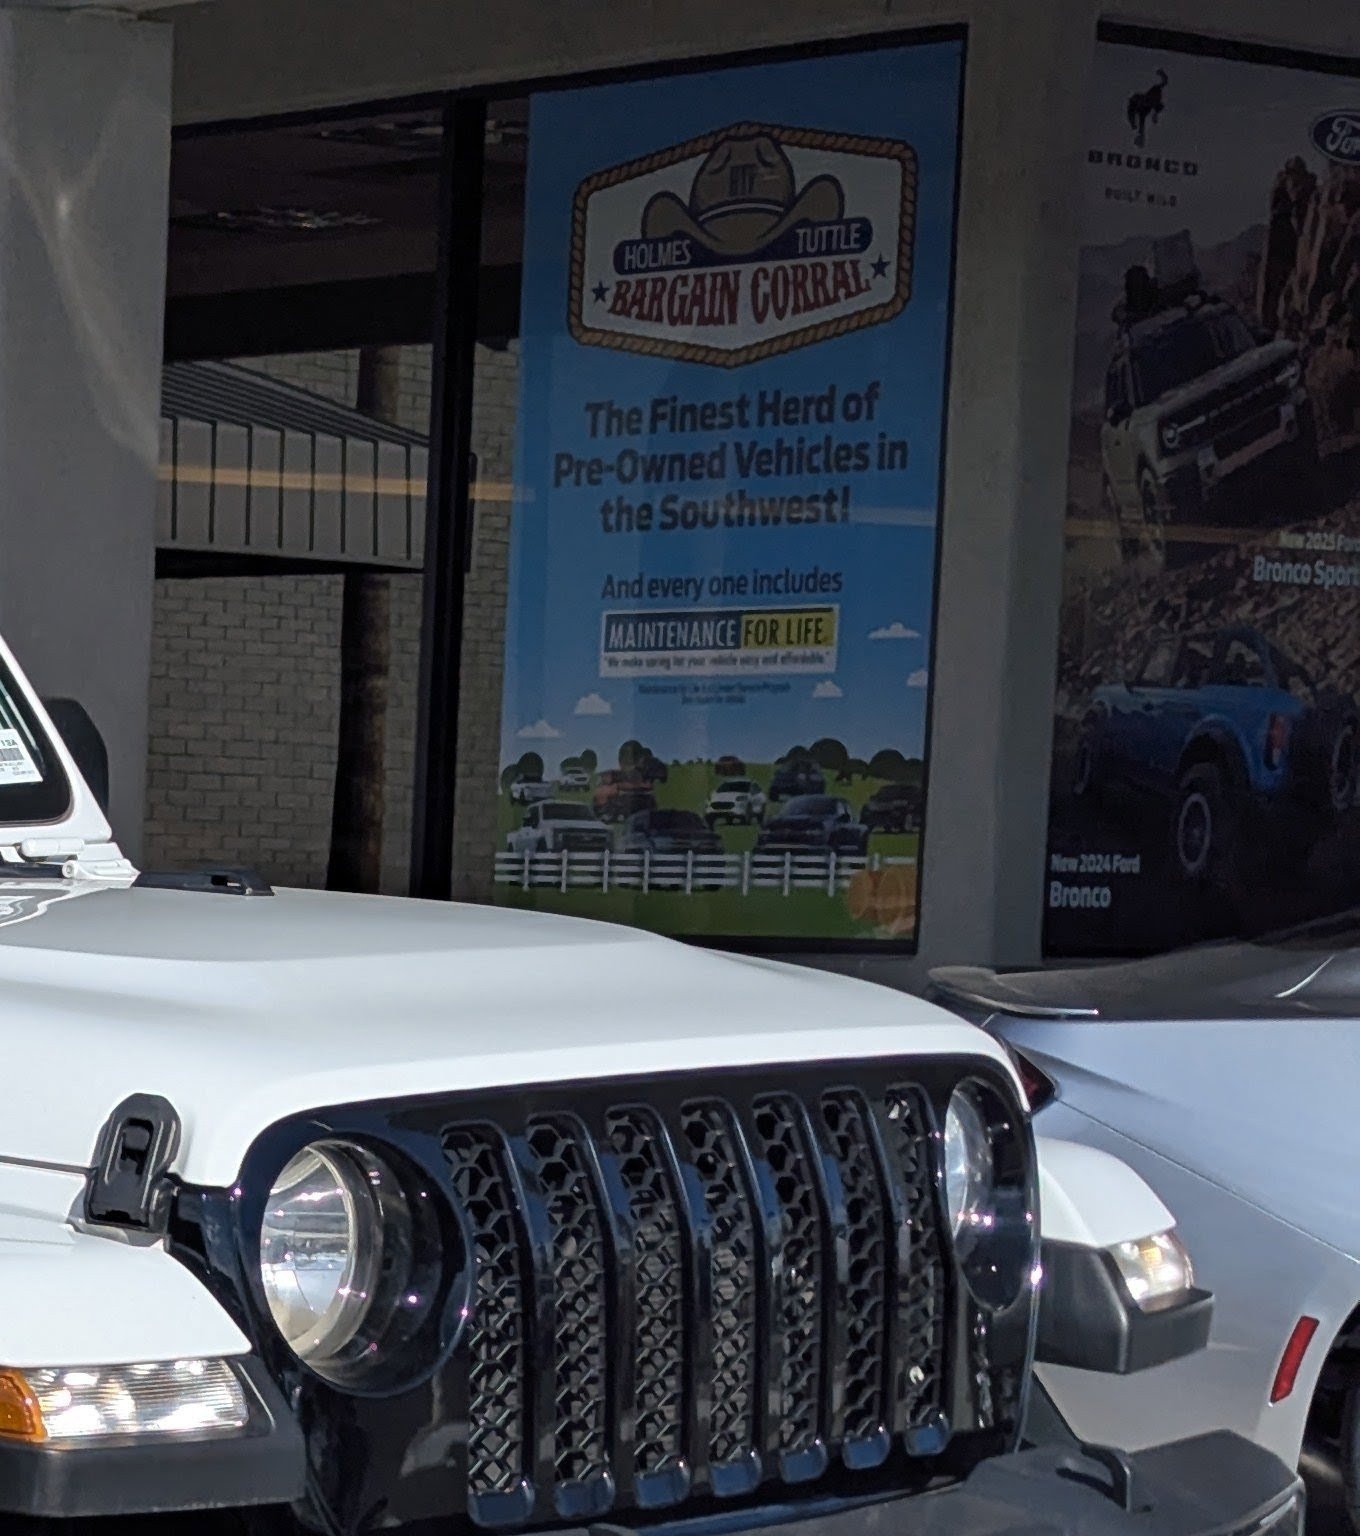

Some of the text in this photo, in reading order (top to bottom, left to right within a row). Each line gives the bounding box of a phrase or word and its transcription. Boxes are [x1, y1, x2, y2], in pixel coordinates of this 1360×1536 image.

[1088, 149, 1198, 176] BRONCO
[624, 223, 861, 269] HOLMES TUTTLE
[607, 258, 872, 327] BARGAIN CORRAL
[586, 381, 880, 438] The Finest Herd of
[553, 432, 908, 489] Pre-Owned Vehicles in
[600, 486, 851, 533] the Southwest!
[600, 566, 843, 603] And every one includes
[1253, 555, 1311, 586] Bronco
[608, 616, 824, 651] MAINTENANCE FOR LIFE
[1051, 852, 1141, 875] New 2024 Ford
[1049, 880, 1112, 908] Bronco
